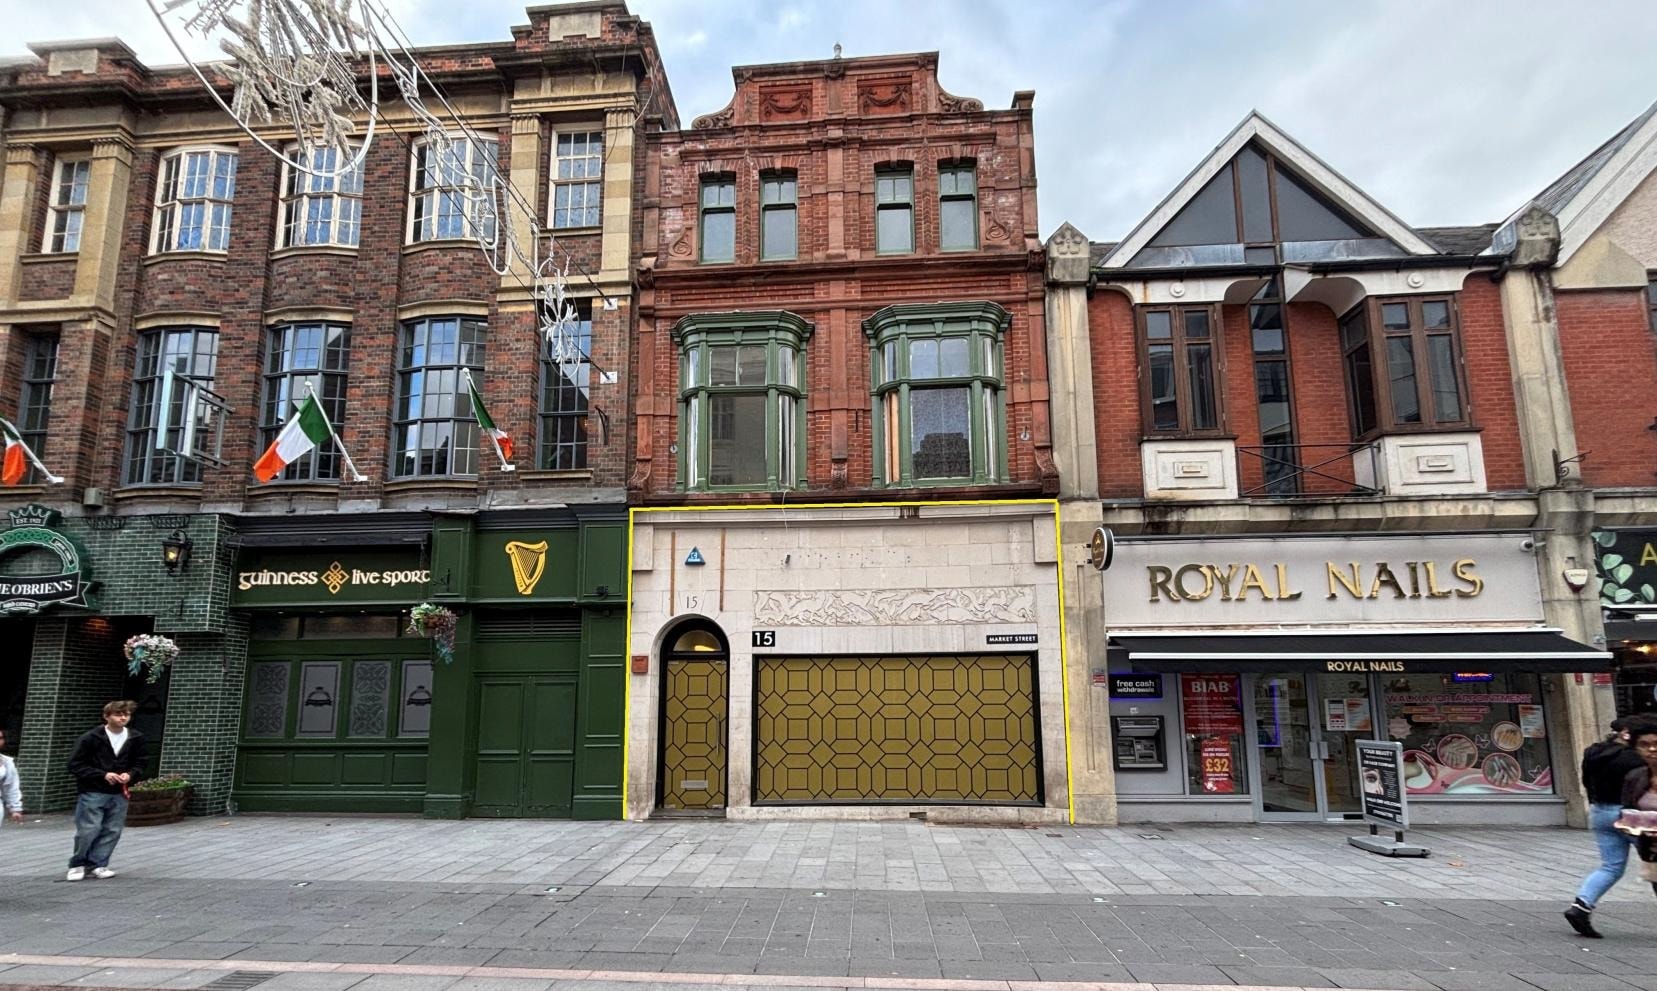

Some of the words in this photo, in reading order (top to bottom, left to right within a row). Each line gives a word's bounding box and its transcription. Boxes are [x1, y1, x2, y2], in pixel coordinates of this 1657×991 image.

[351, 569, 381, 585] live
[1147, 562, 1302, 602] ROYAL
[1327, 558, 1484, 600] NAILS
[11, 580, 73, 595] O'BRIEN'S
[686, 596, 698, 609] 15
[755, 631, 773, 646] 15
[1326, 660, 1367, 673] ROYAL
[1369, 660, 1404, 673] NAILS
[1116, 679, 1134, 687] free
[1135, 679, 1155, 687] cash
[1191, 681, 1229, 693] BIAB
[1205, 758, 1229, 772] £32
